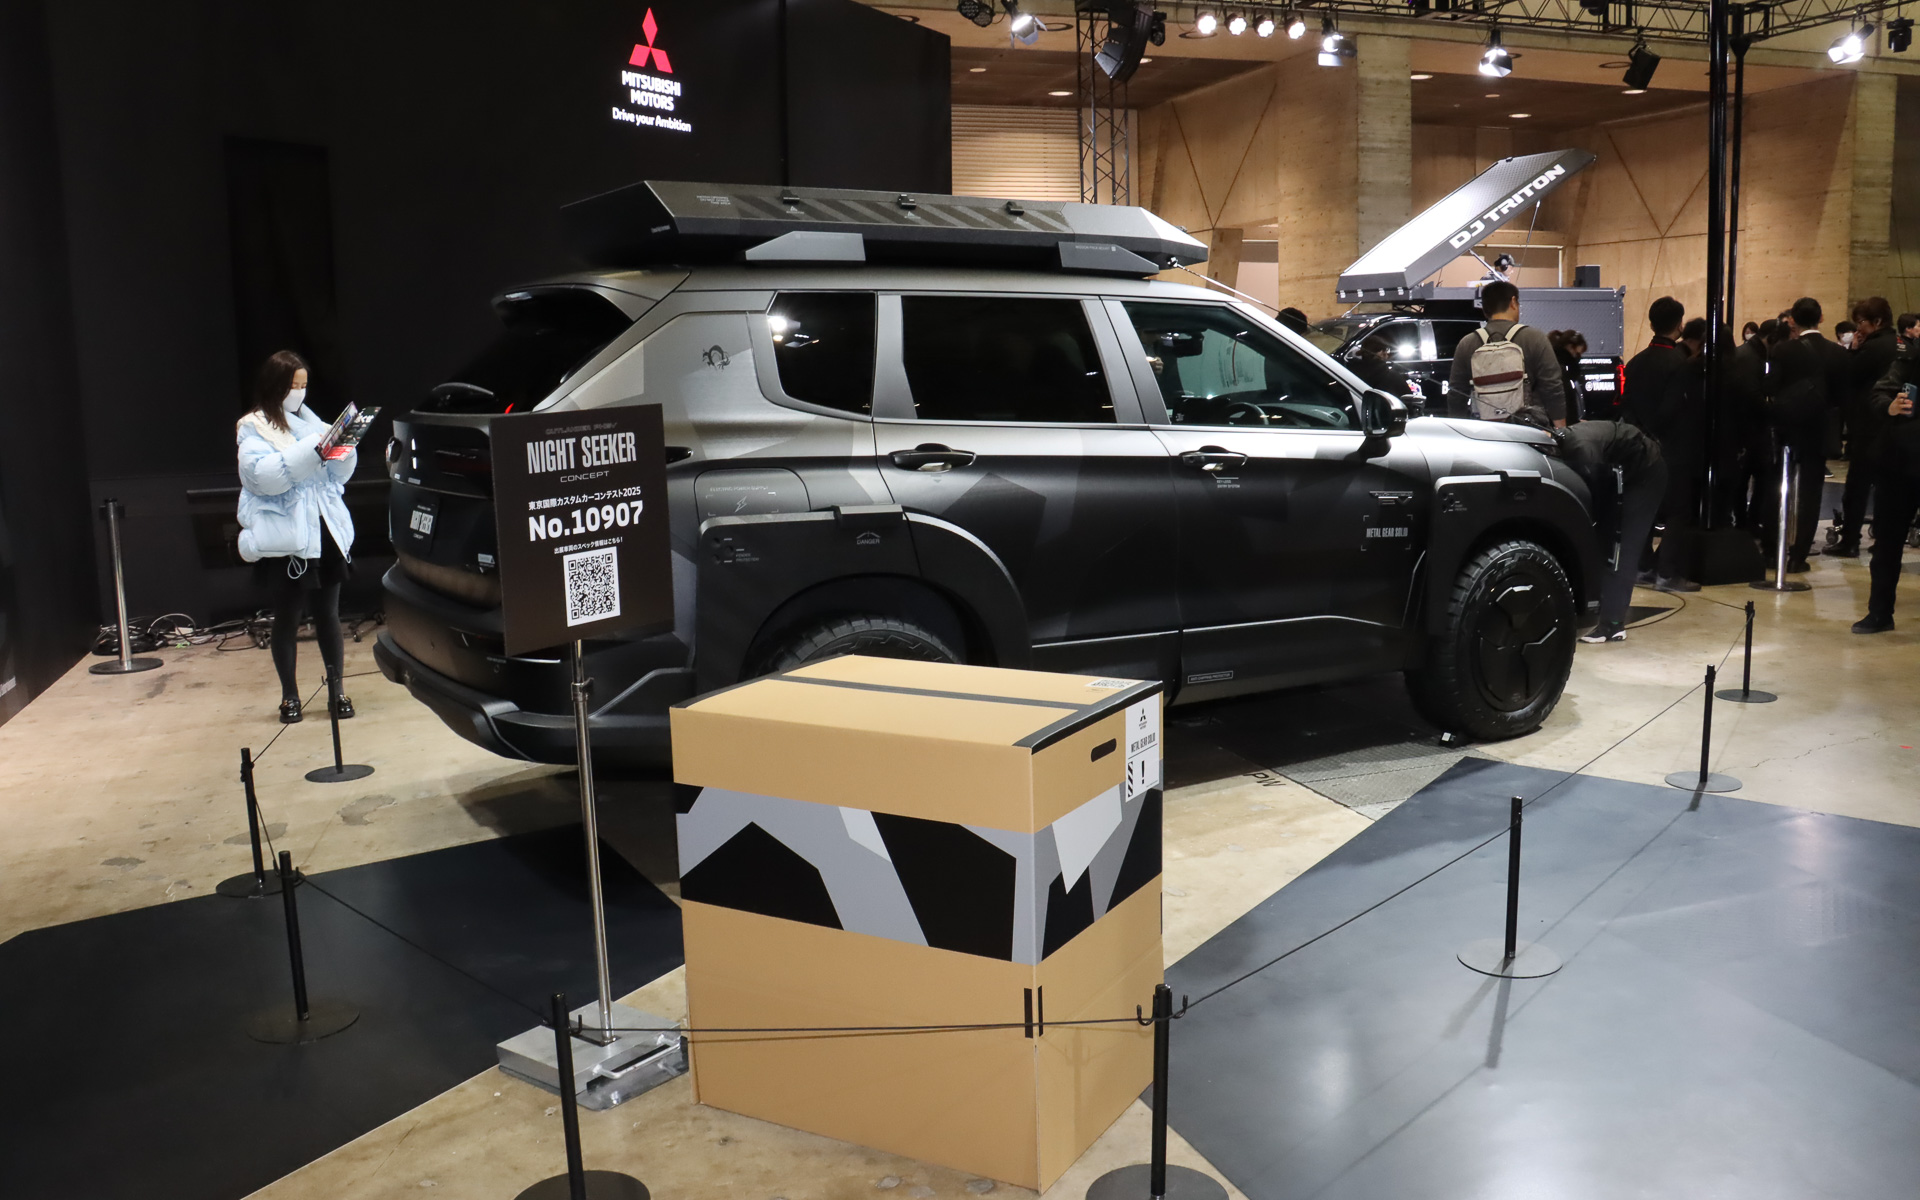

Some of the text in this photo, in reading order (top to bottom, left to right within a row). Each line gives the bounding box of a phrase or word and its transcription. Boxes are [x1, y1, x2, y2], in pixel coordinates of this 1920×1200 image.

[621, 70, 682, 97] MITSUBISHI
[630, 88, 675, 112] MOTORS
[612, 106, 692, 133] Drive your Ambition
[1449, 163, 1567, 250] DJ TRITON
[526, 431, 637, 475] NIGHT SEEKER
[560, 470, 610, 483] CONCEPT
[528, 486, 642, 511] 東京国際カスタムカーコンテスト2025
[528, 500, 644, 542] No.10907
[1366, 527, 1408, 538] METAL GEAR SOLID
[1130, 732, 1156, 753] METAL GEAR SOLID
